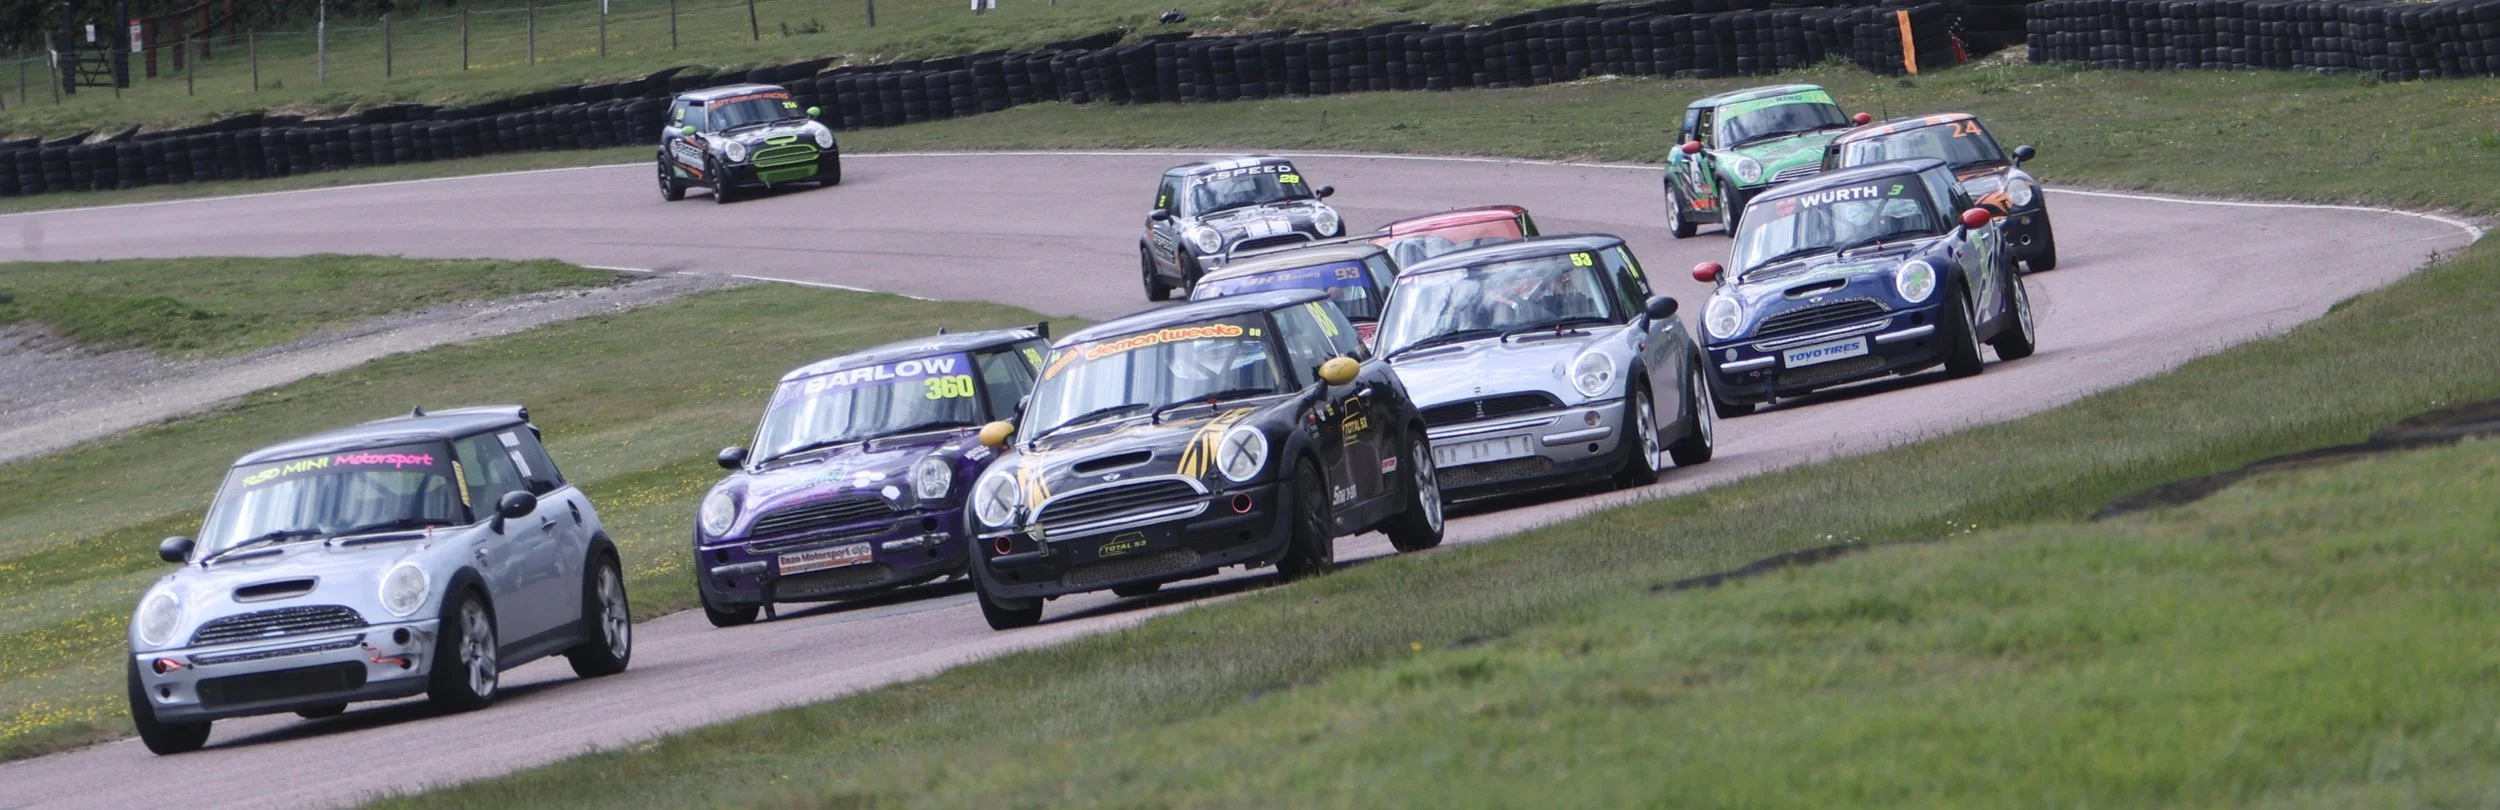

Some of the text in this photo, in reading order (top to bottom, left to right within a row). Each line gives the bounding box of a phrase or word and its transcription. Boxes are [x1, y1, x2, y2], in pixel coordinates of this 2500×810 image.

[1945, 120, 1983, 138] 24
[1191, 165, 1292, 188] ATSPEED
[1800, 185, 1878, 208] WURTH
[1887, 184, 1904, 196] 3
[1569, 252, 1593, 267] 53
[1335, 266, 1360, 280] 93
[1085, 334, 1158, 360] demon
[1158, 324, 1243, 343] tweeks
[1789, 342, 1860, 362] TOYO TIRES
[803, 358, 956, 396] BARLOW
[925, 374, 975, 400] 360
[282, 456, 329, 477] MINI
[334, 452, 434, 469] Motorsport
[801, 548, 850, 561] Motorsport
[1105, 543, 1132, 552] TOTAL
